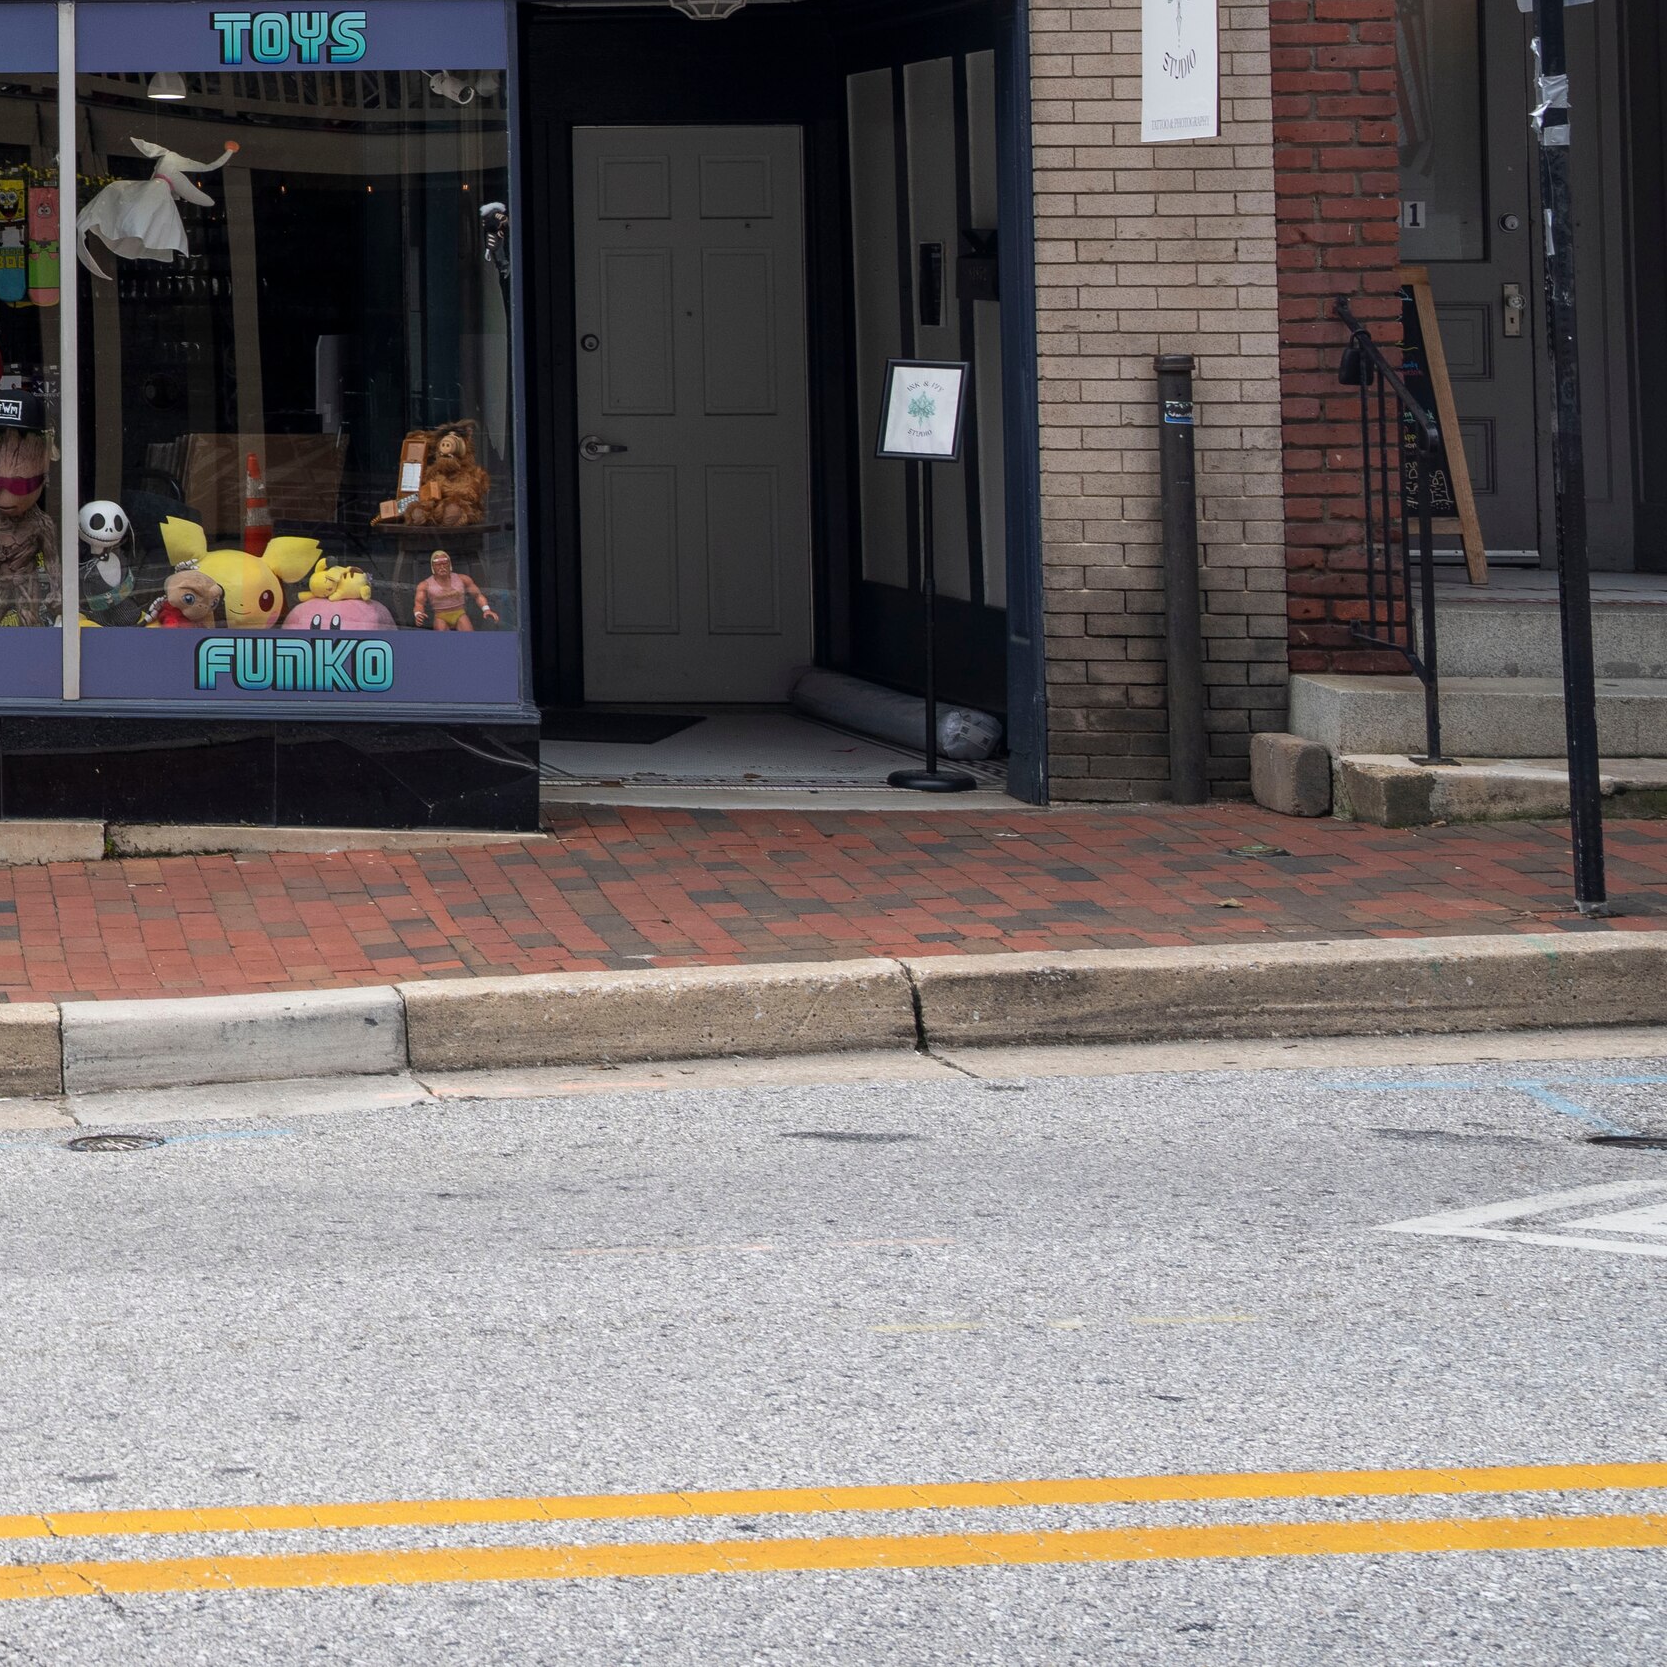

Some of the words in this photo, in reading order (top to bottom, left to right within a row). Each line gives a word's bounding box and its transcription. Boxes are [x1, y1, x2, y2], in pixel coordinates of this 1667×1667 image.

[210, 10, 368, 65] TOYS
[1162, 48, 1197, 80] STUDIO
[1409, 203, 1420, 227] 1
[907, 381, 920, 392] INK
[194, 636, 395, 693] FUNKO
